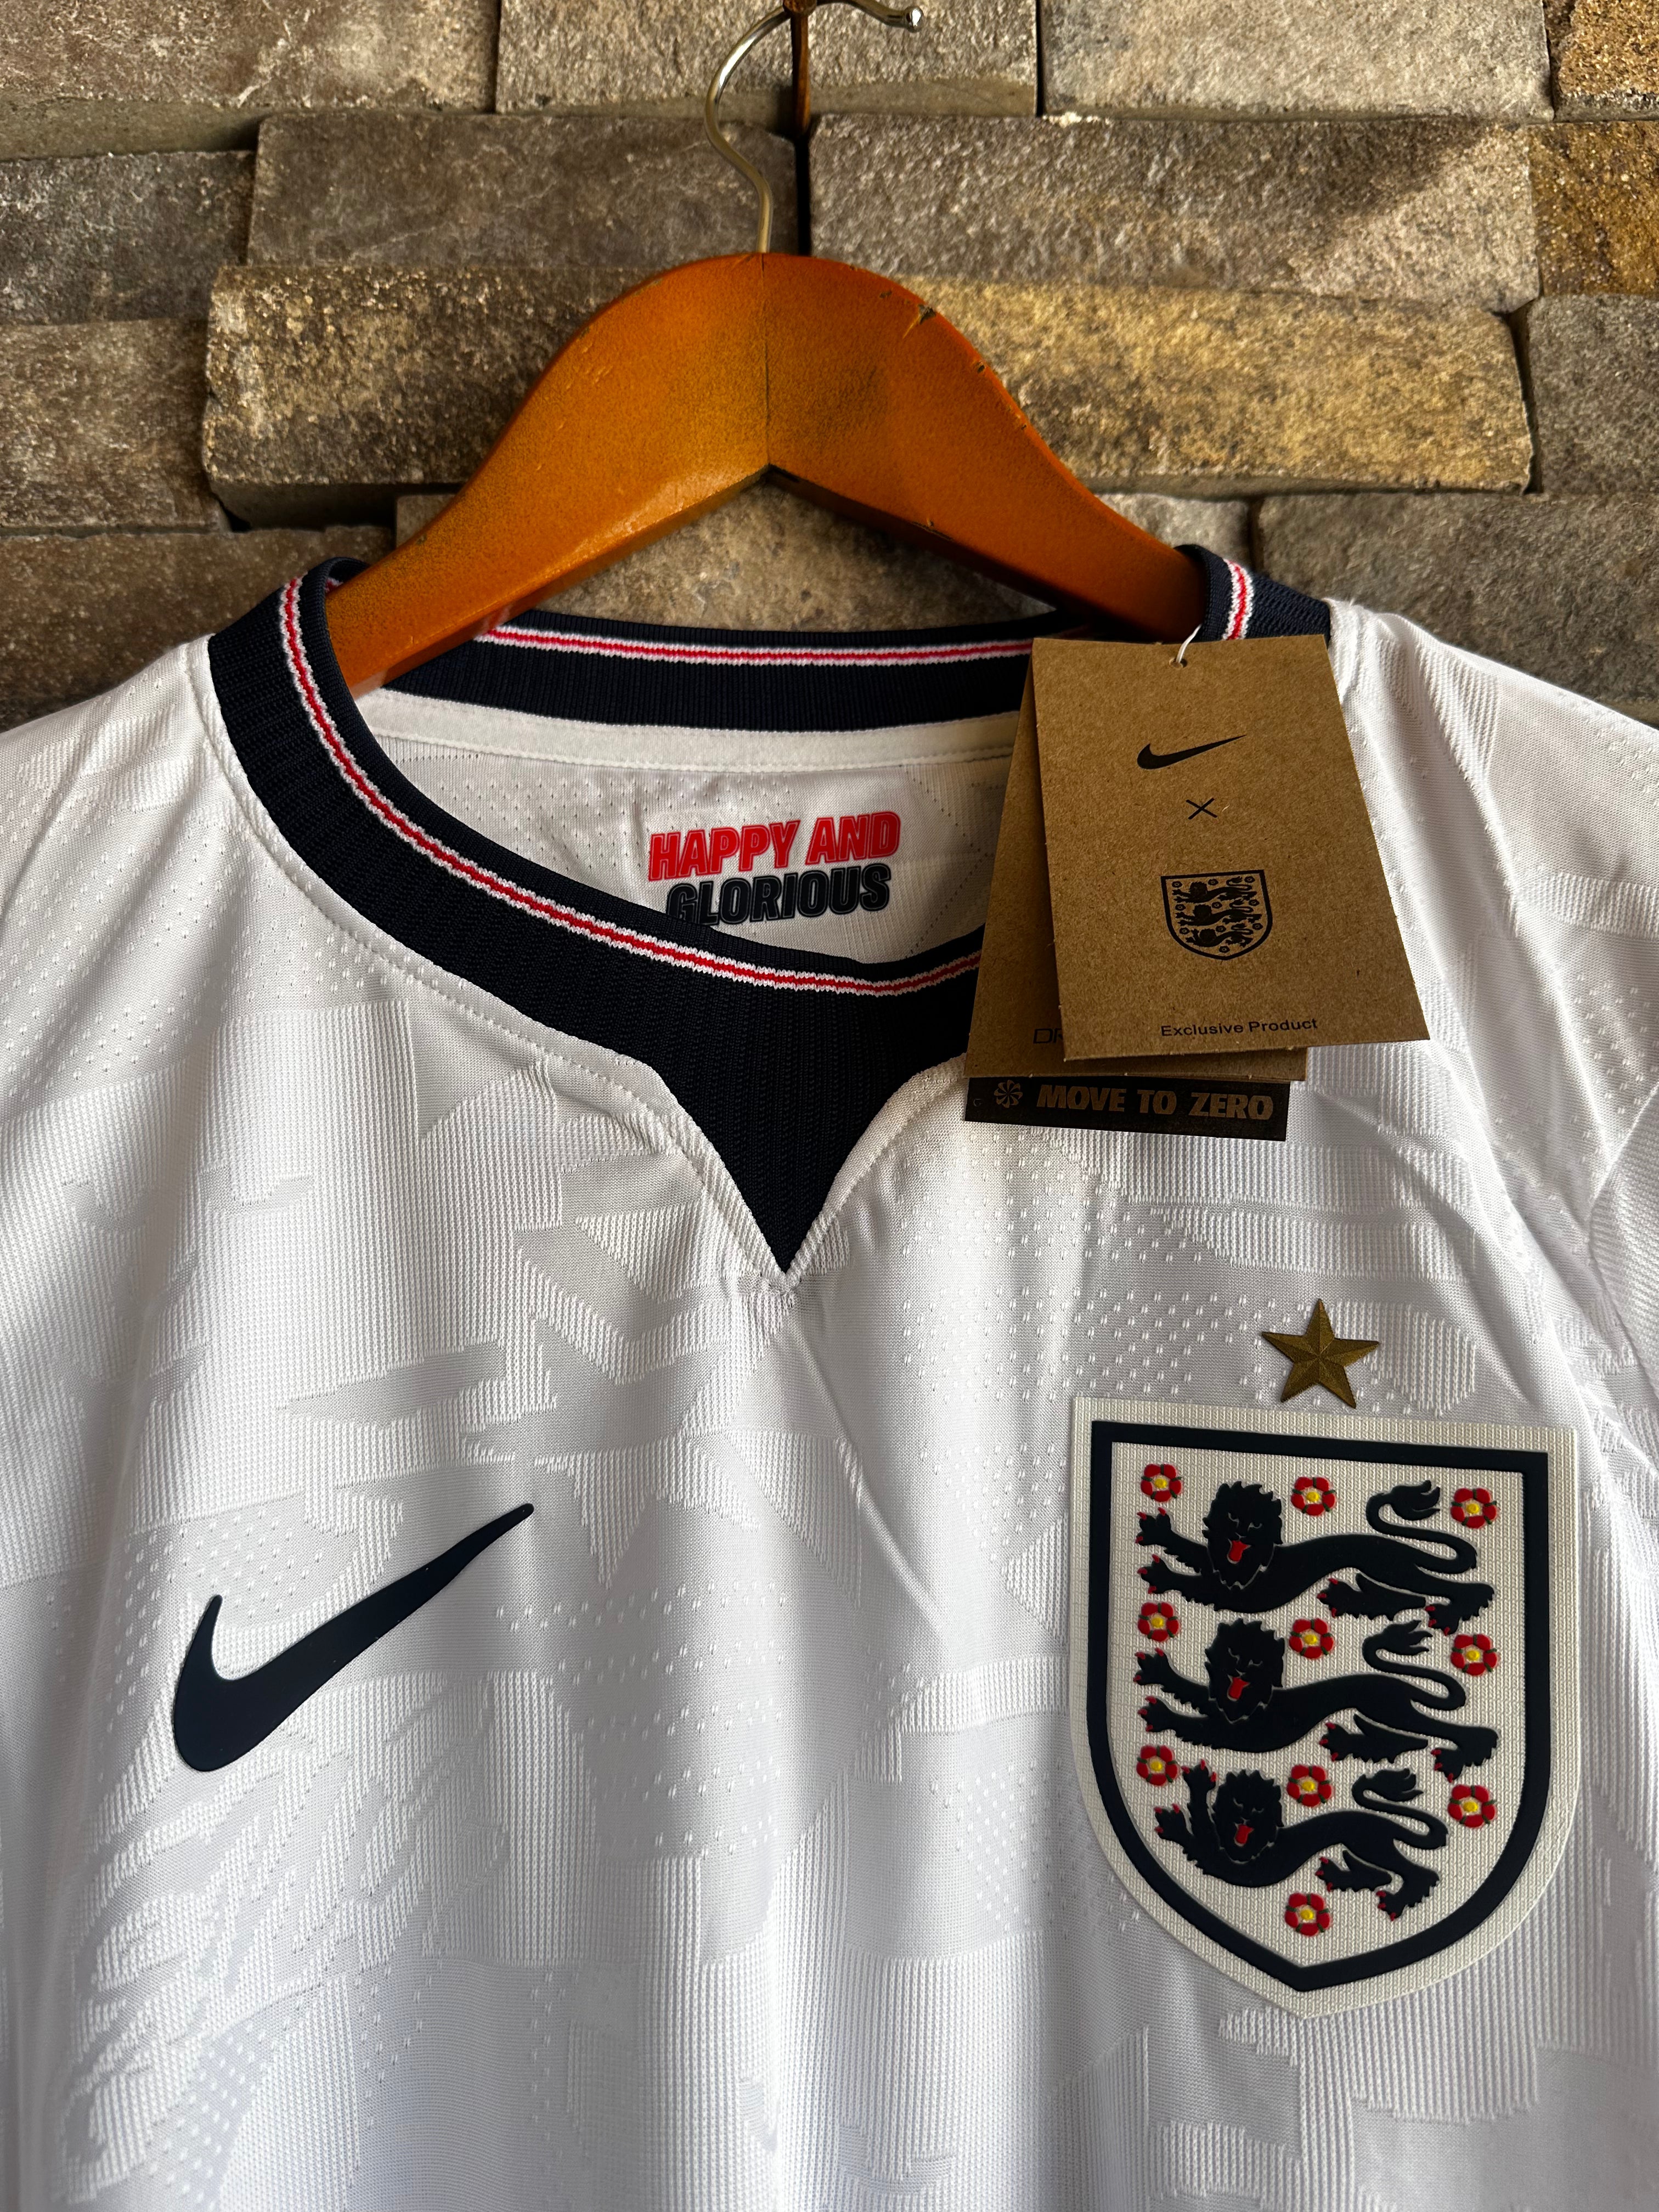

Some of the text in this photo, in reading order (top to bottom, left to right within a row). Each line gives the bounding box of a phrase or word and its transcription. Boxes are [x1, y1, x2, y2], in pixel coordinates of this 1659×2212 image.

[648, 810, 901, 882] HAPPY AND
[665, 862, 892, 926] GLORIOUS
[1160, 1018, 1318, 1037] Exclusive Product
[1036, 1084, 1273, 1120] MOVE TO ZERO
